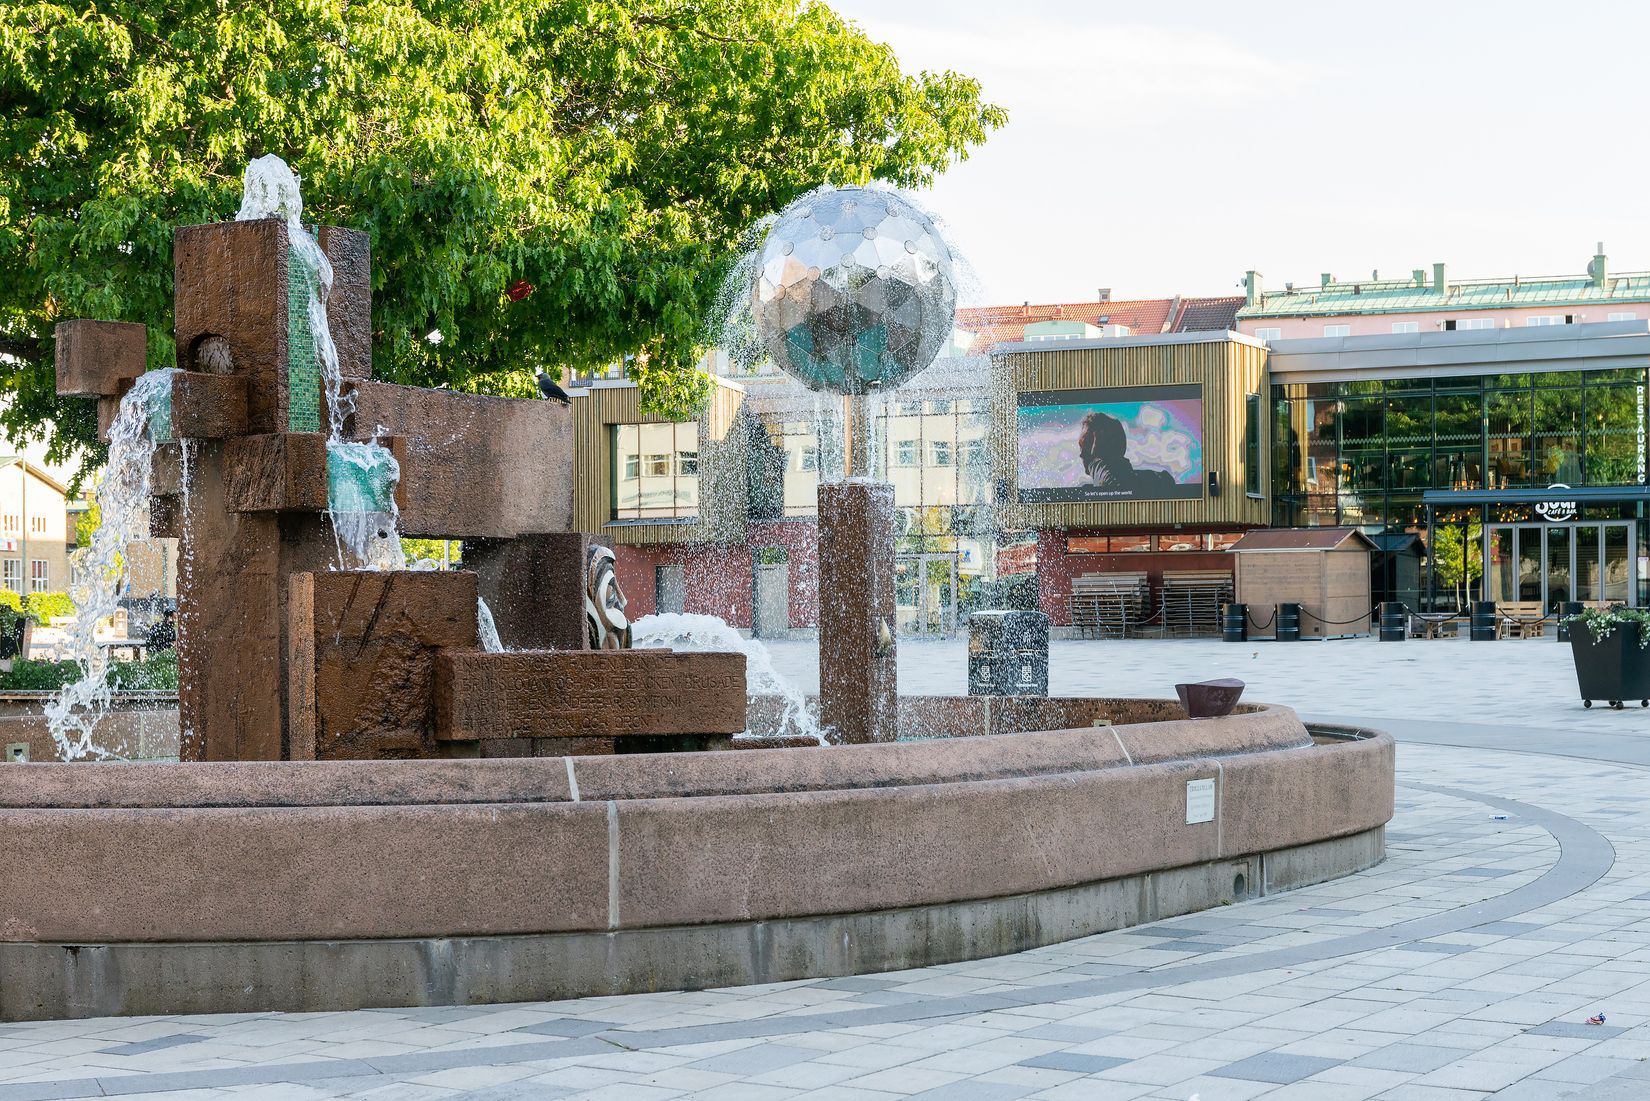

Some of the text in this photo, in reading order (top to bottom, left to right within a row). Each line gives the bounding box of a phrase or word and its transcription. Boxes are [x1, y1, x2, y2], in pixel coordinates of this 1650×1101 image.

[1636, 385, 1646, 483] RESTAURANG
[684, 674, 741, 690] BRUSADE
[627, 694, 682, 710] SYMFONI
